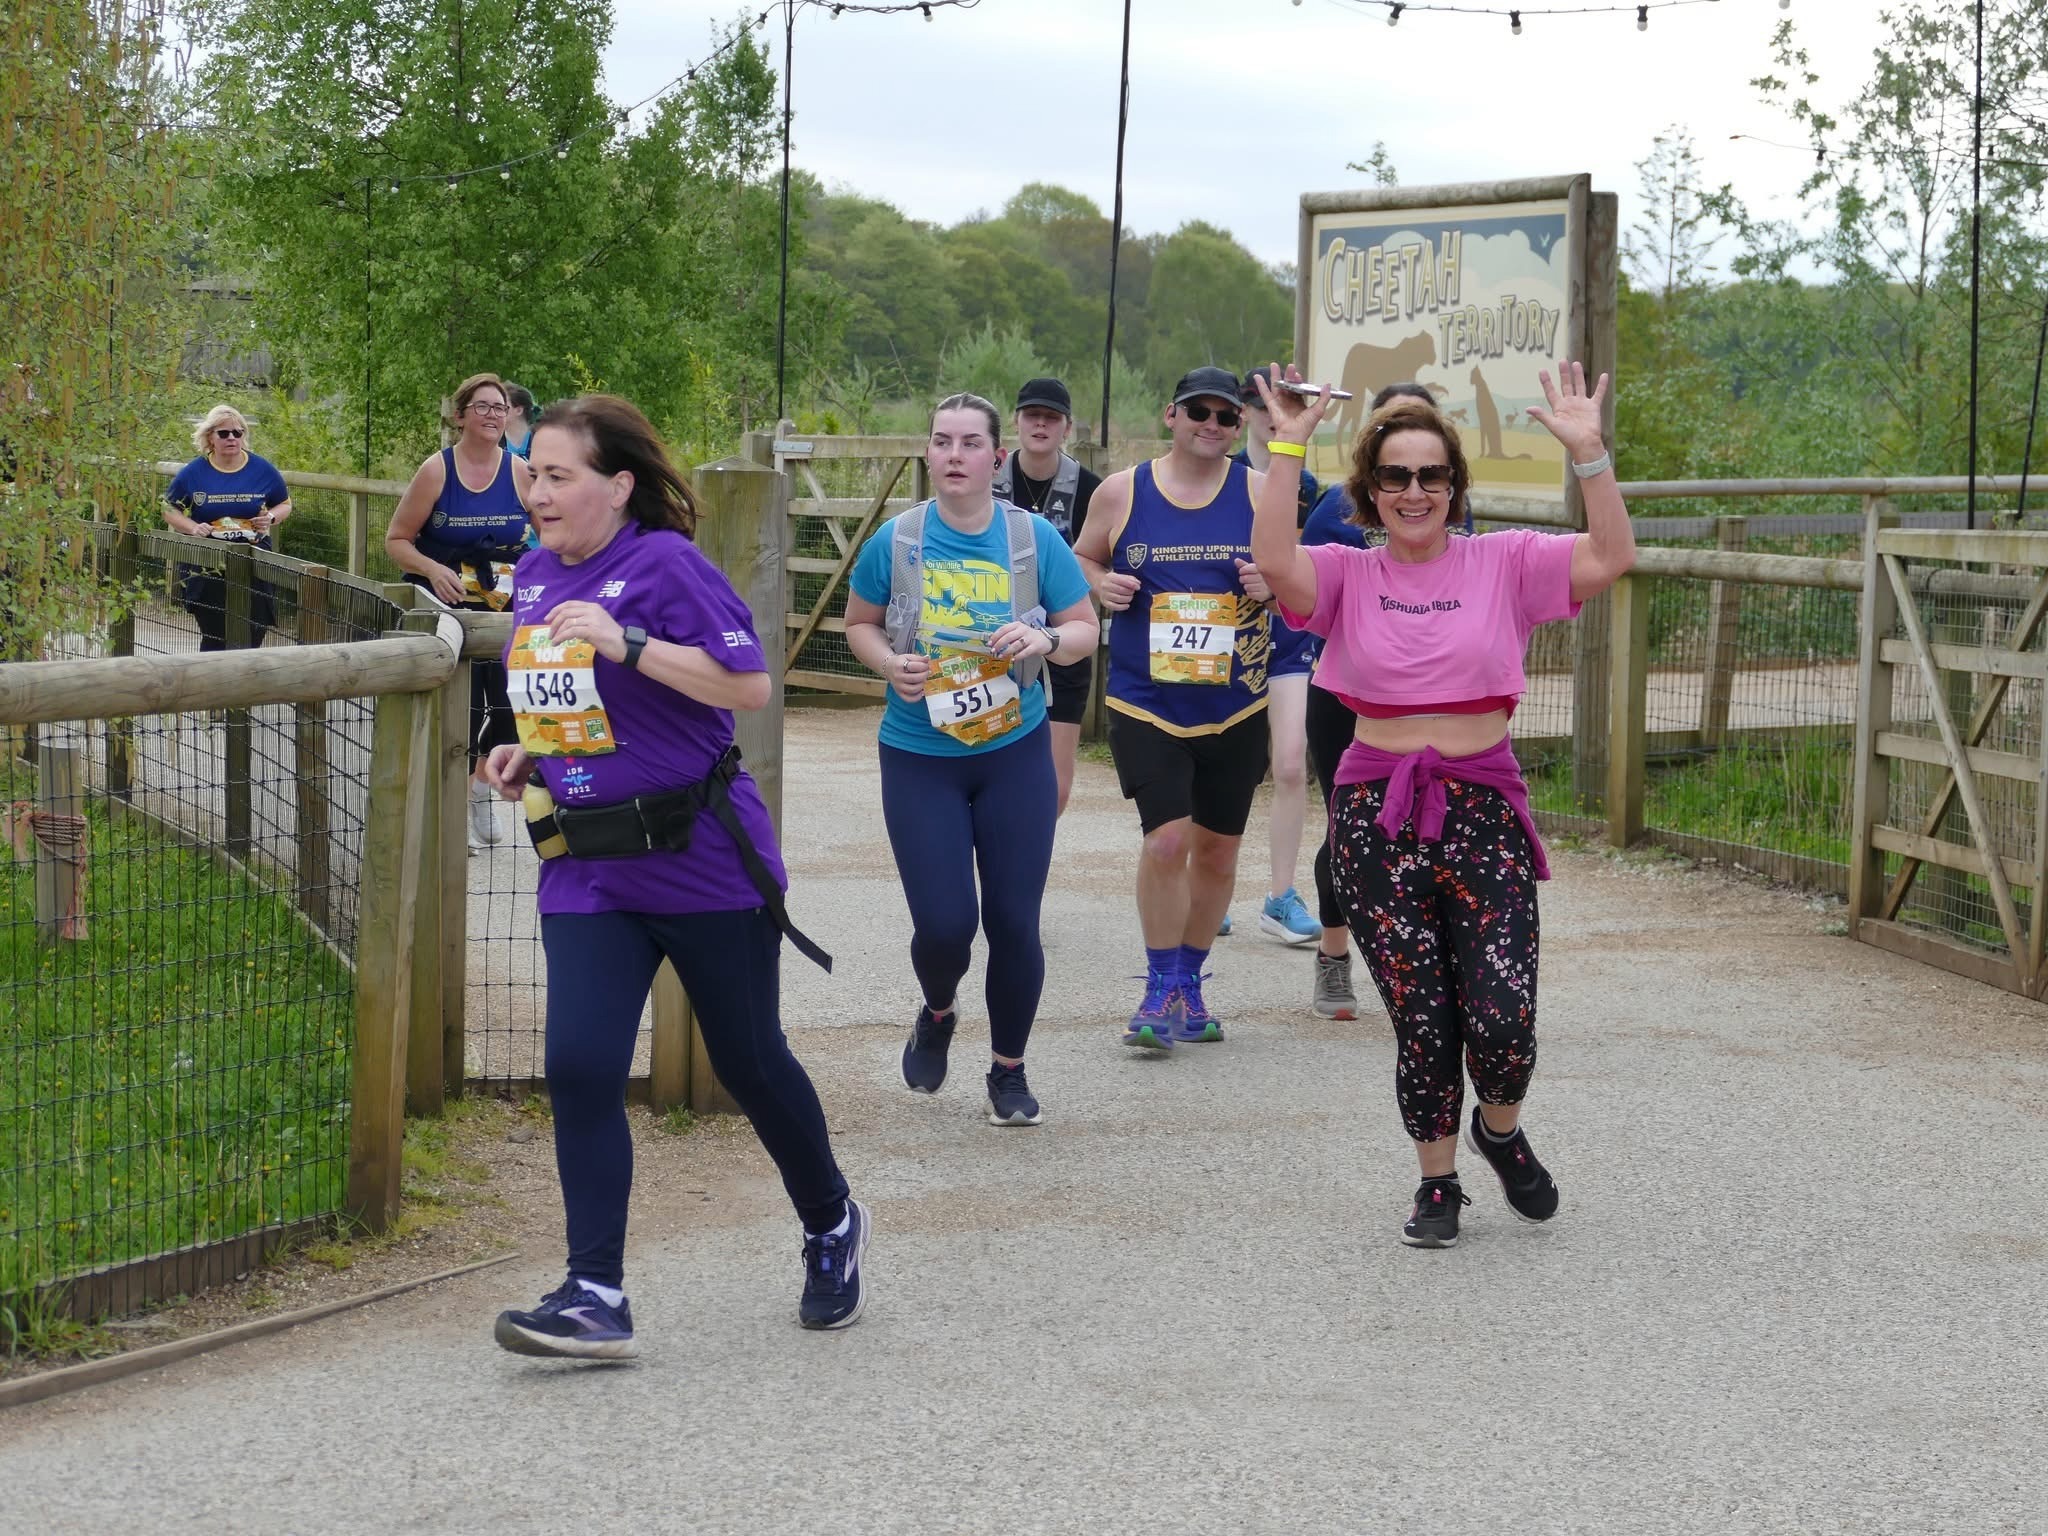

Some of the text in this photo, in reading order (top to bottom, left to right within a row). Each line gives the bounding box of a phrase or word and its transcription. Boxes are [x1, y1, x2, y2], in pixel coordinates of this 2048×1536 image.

[1323, 230, 1462, 325] CHEETAH
[1437, 295, 1560, 366] TERRITORY
[1151, 545, 1252, 555] KINGSTON UPON HU
[1152, 552, 1230, 562] ATHLETIC CLUB
[936, 561, 961, 570] Wildlife
[922, 570, 1010, 603] SPRIN
[1170, 599, 1219, 611] SPRING
[1431, 599, 1462, 612] IBIZA
[1178, 609, 1209, 620] 10K
[1171, 625, 1213, 650] 247
[942, 656, 989, 677] SPRING
[953, 667, 983, 685] 10K
[525, 671, 577, 708] 1548
[952, 683, 993, 718] 551
[566, 766, 584, 776] LDN
[567, 785, 591, 795] 2022
